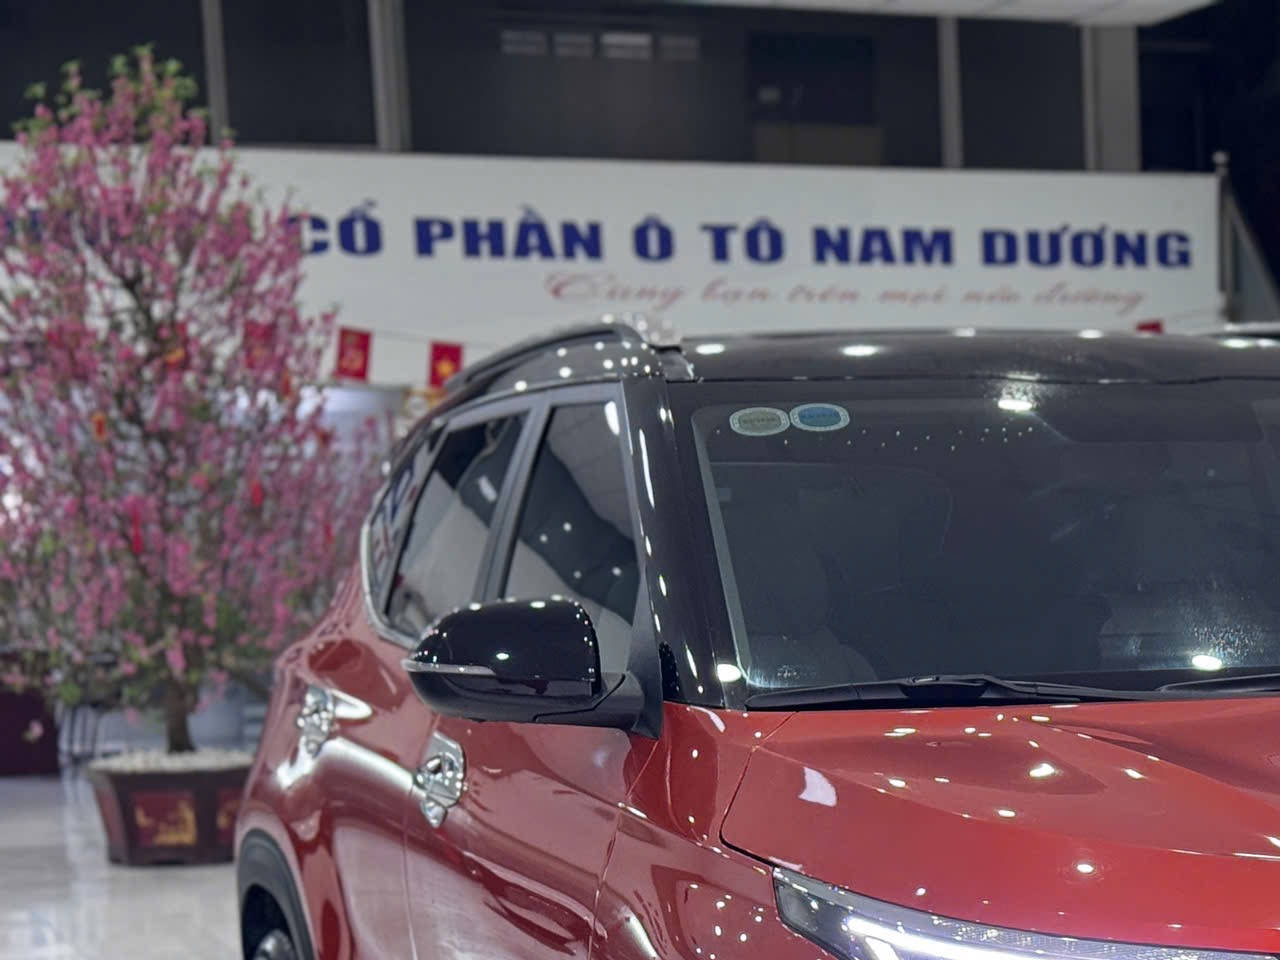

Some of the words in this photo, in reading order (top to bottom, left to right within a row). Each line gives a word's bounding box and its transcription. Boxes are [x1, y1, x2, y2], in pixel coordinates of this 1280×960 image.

[413, 202, 606, 264] PHẦN
[631, 211, 678, 265] Ô
[700, 216, 791, 266] TÔ
[812, 223, 955, 269] NAM
[979, 220, 1195, 273] DƯƠNG
